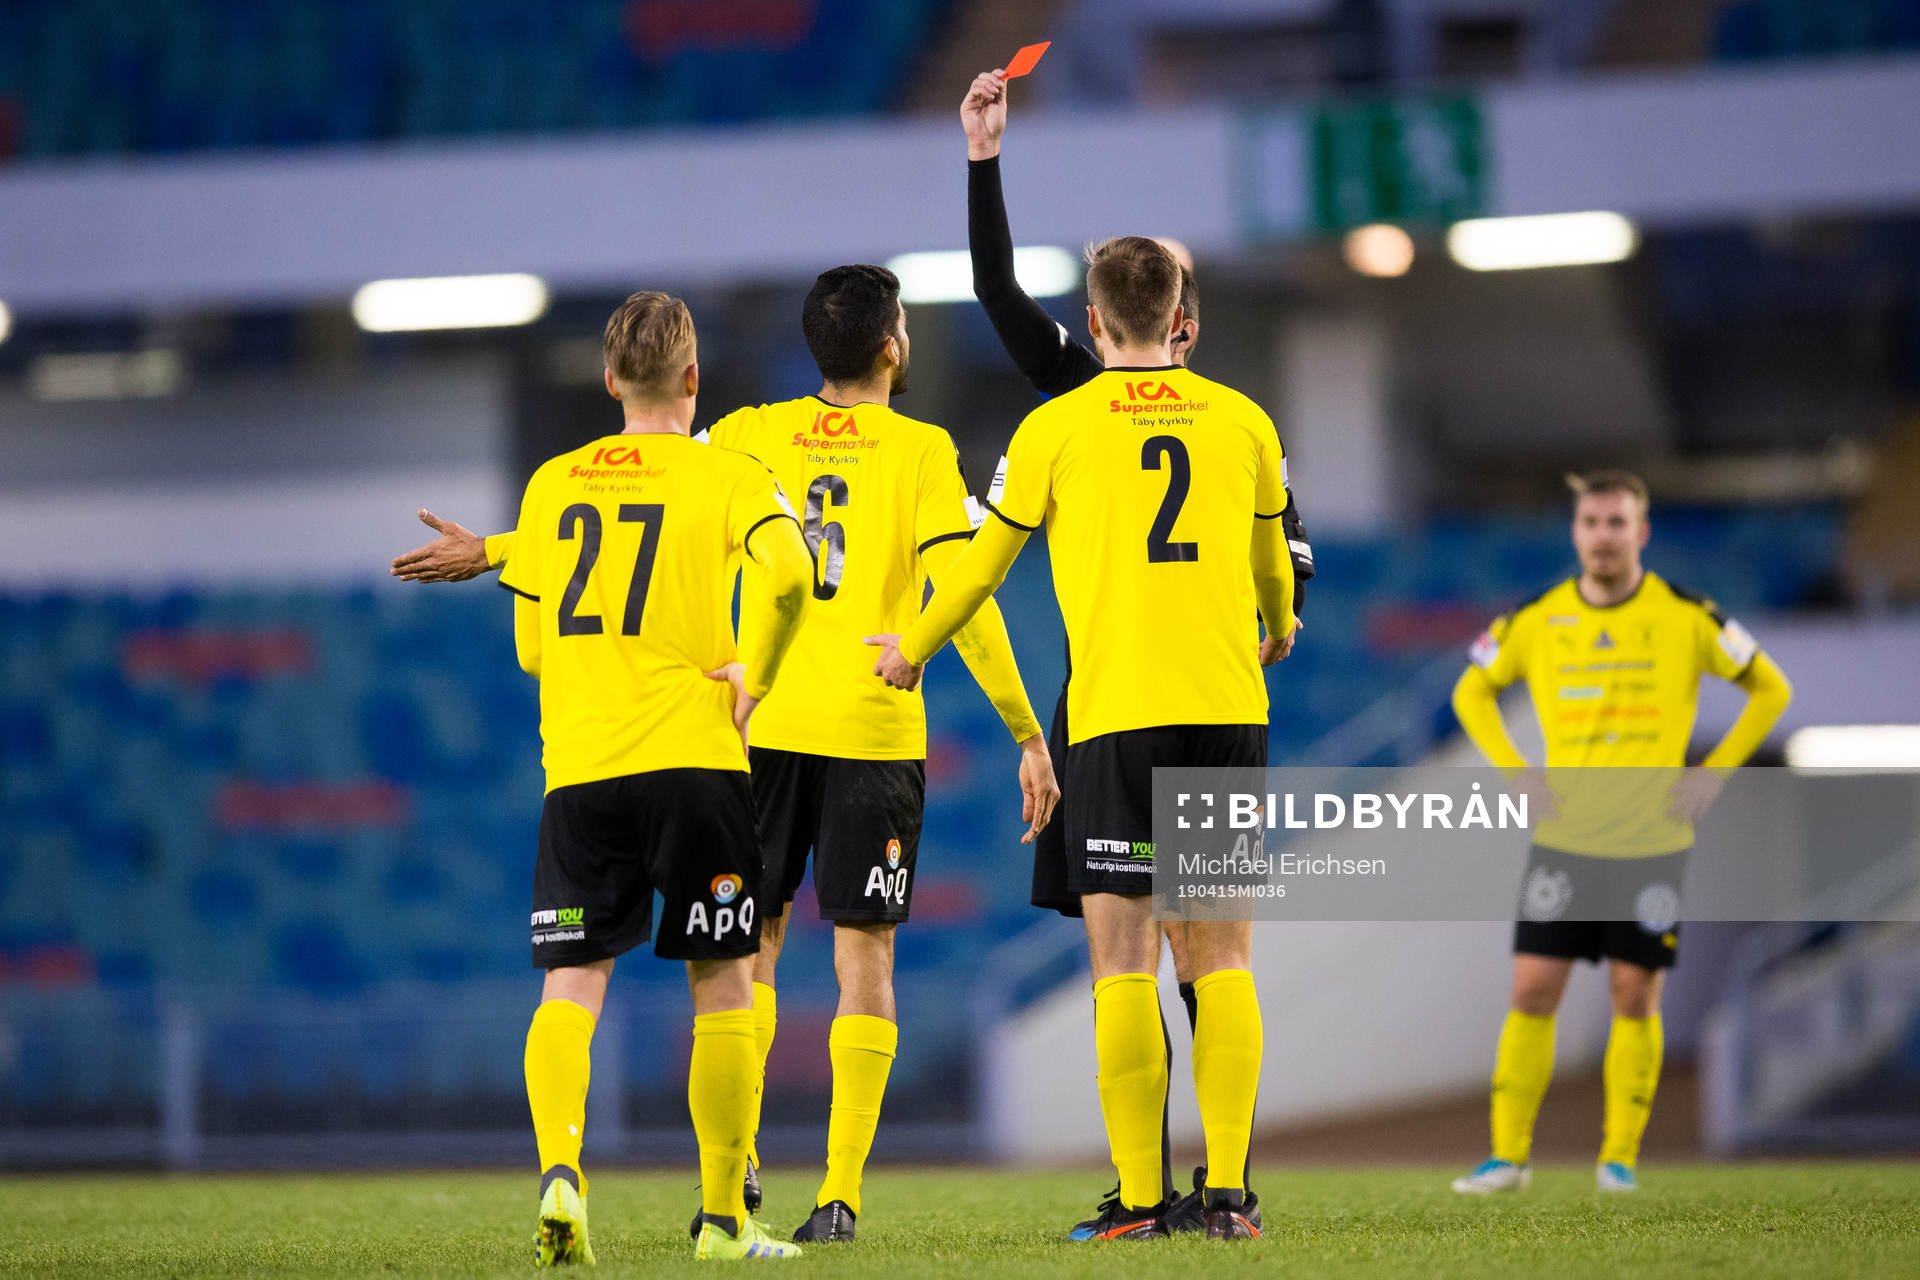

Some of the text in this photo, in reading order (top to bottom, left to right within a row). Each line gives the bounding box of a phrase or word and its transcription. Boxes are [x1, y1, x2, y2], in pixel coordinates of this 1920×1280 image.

[1125, 381, 1182, 401] ICA
[1110, 399, 1208, 416] Supermarket
[812, 411, 859, 437] ICA
[1131, 416, 1194, 427] Täby Kyrkby
[792, 432, 880, 451] Supermarket
[592, 446, 643, 466] ICA
[568, 465, 666, 480] Supermarket
[1141, 435, 1198, 563] 2
[803, 474, 849, 600] 6
[557, 503, 665, 637] 27
[1086, 839, 1157, 855] BETTER YOU
[864, 866, 908, 905] ApQ
[557, 907, 584, 922] YOU
[686, 896, 755, 941] ApQ
